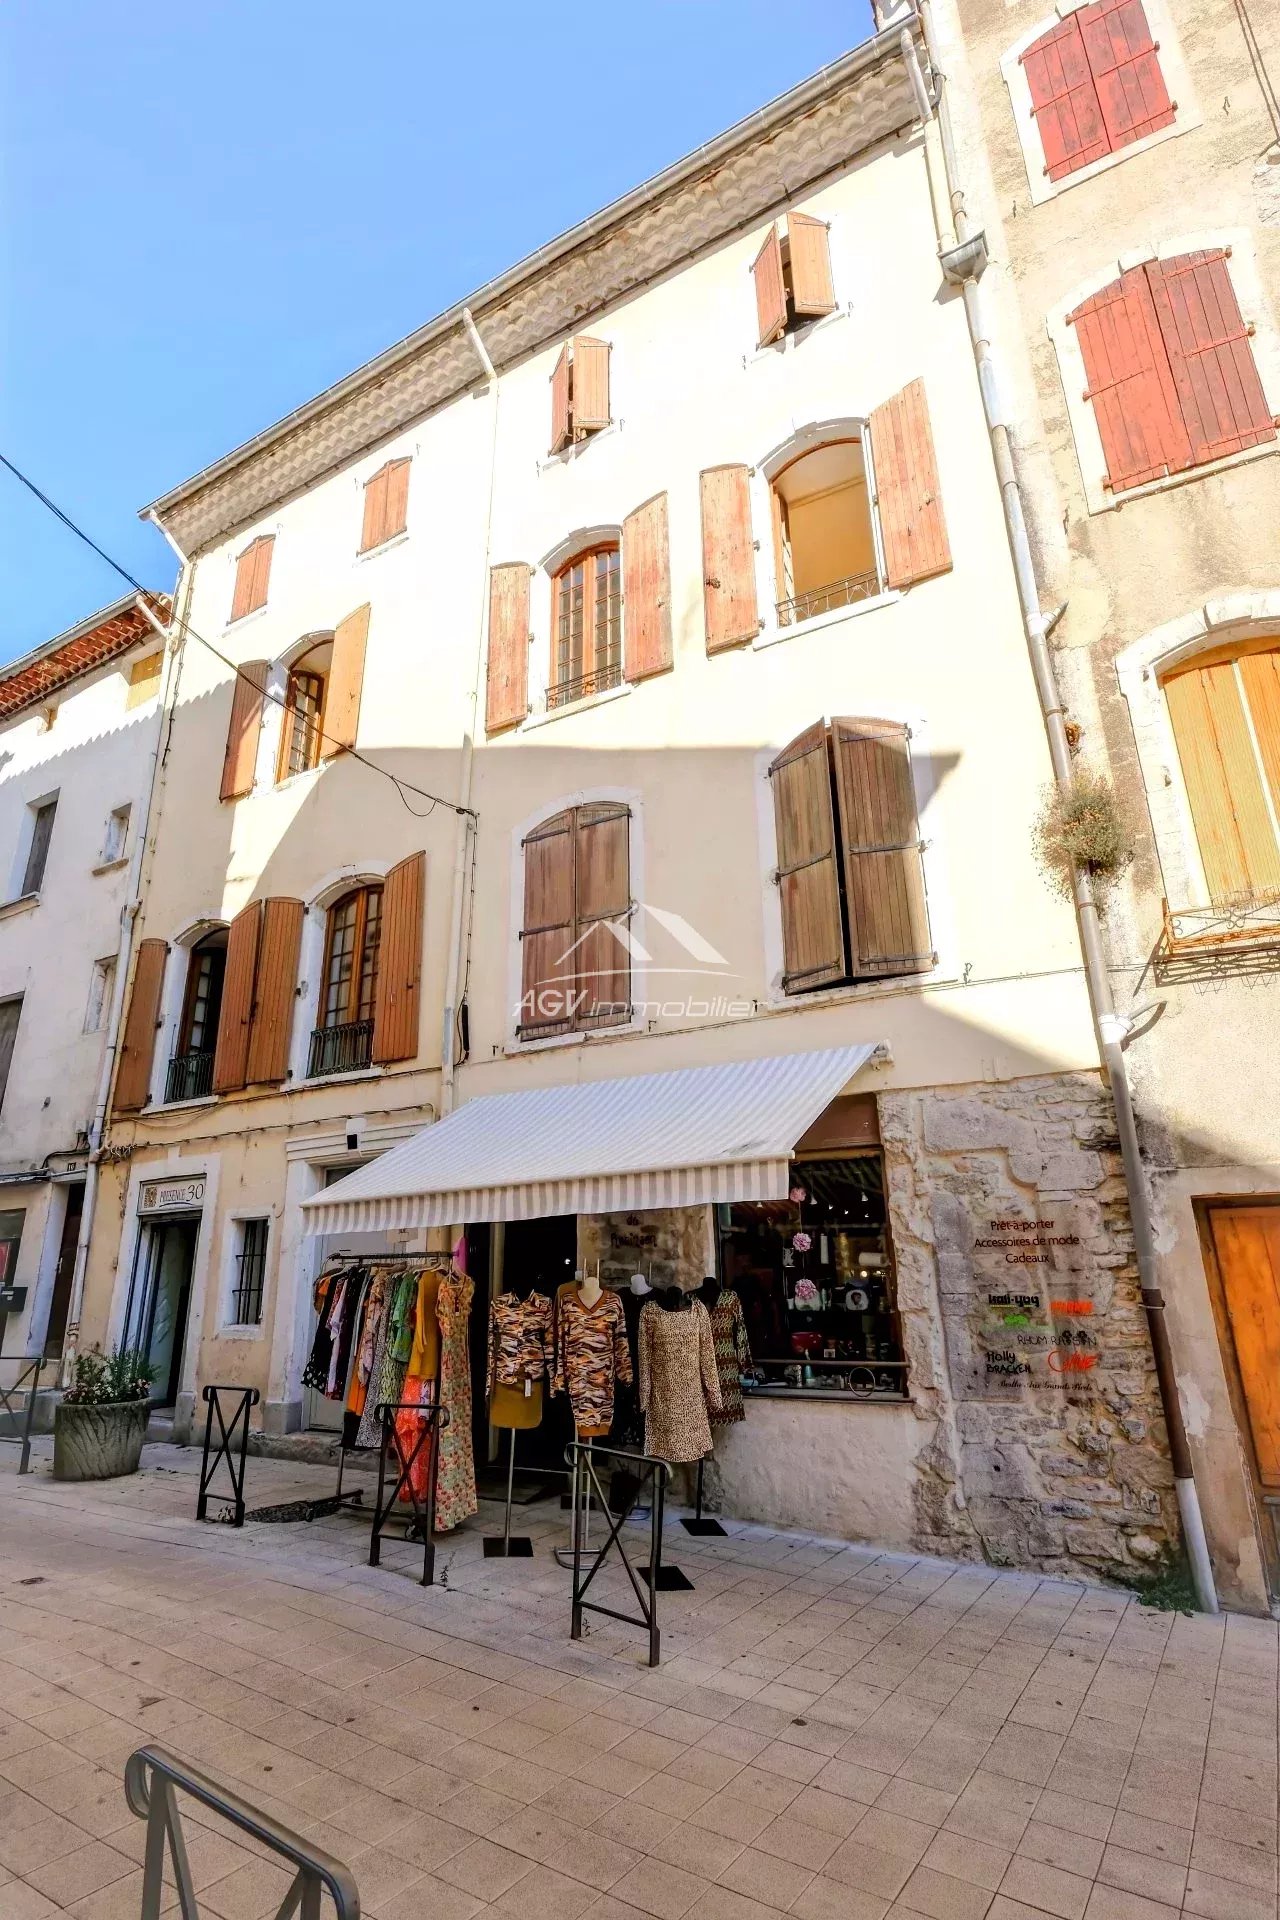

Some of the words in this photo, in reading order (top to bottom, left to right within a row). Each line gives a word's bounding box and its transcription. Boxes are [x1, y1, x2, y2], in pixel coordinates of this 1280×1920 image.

[186, 1183, 204, 1202] 30
[990, 1219, 1055, 1232] Prêt-à-porter
[974, 1236, 1031, 1248] Accessoires
[1032, 1234, 1048, 1246] de
[1048, 1233, 1080, 1246] mode
[1005, 1251, 1050, 1264] Cadeaux
[986, 1363, 1033, 1375] BRACKEN
